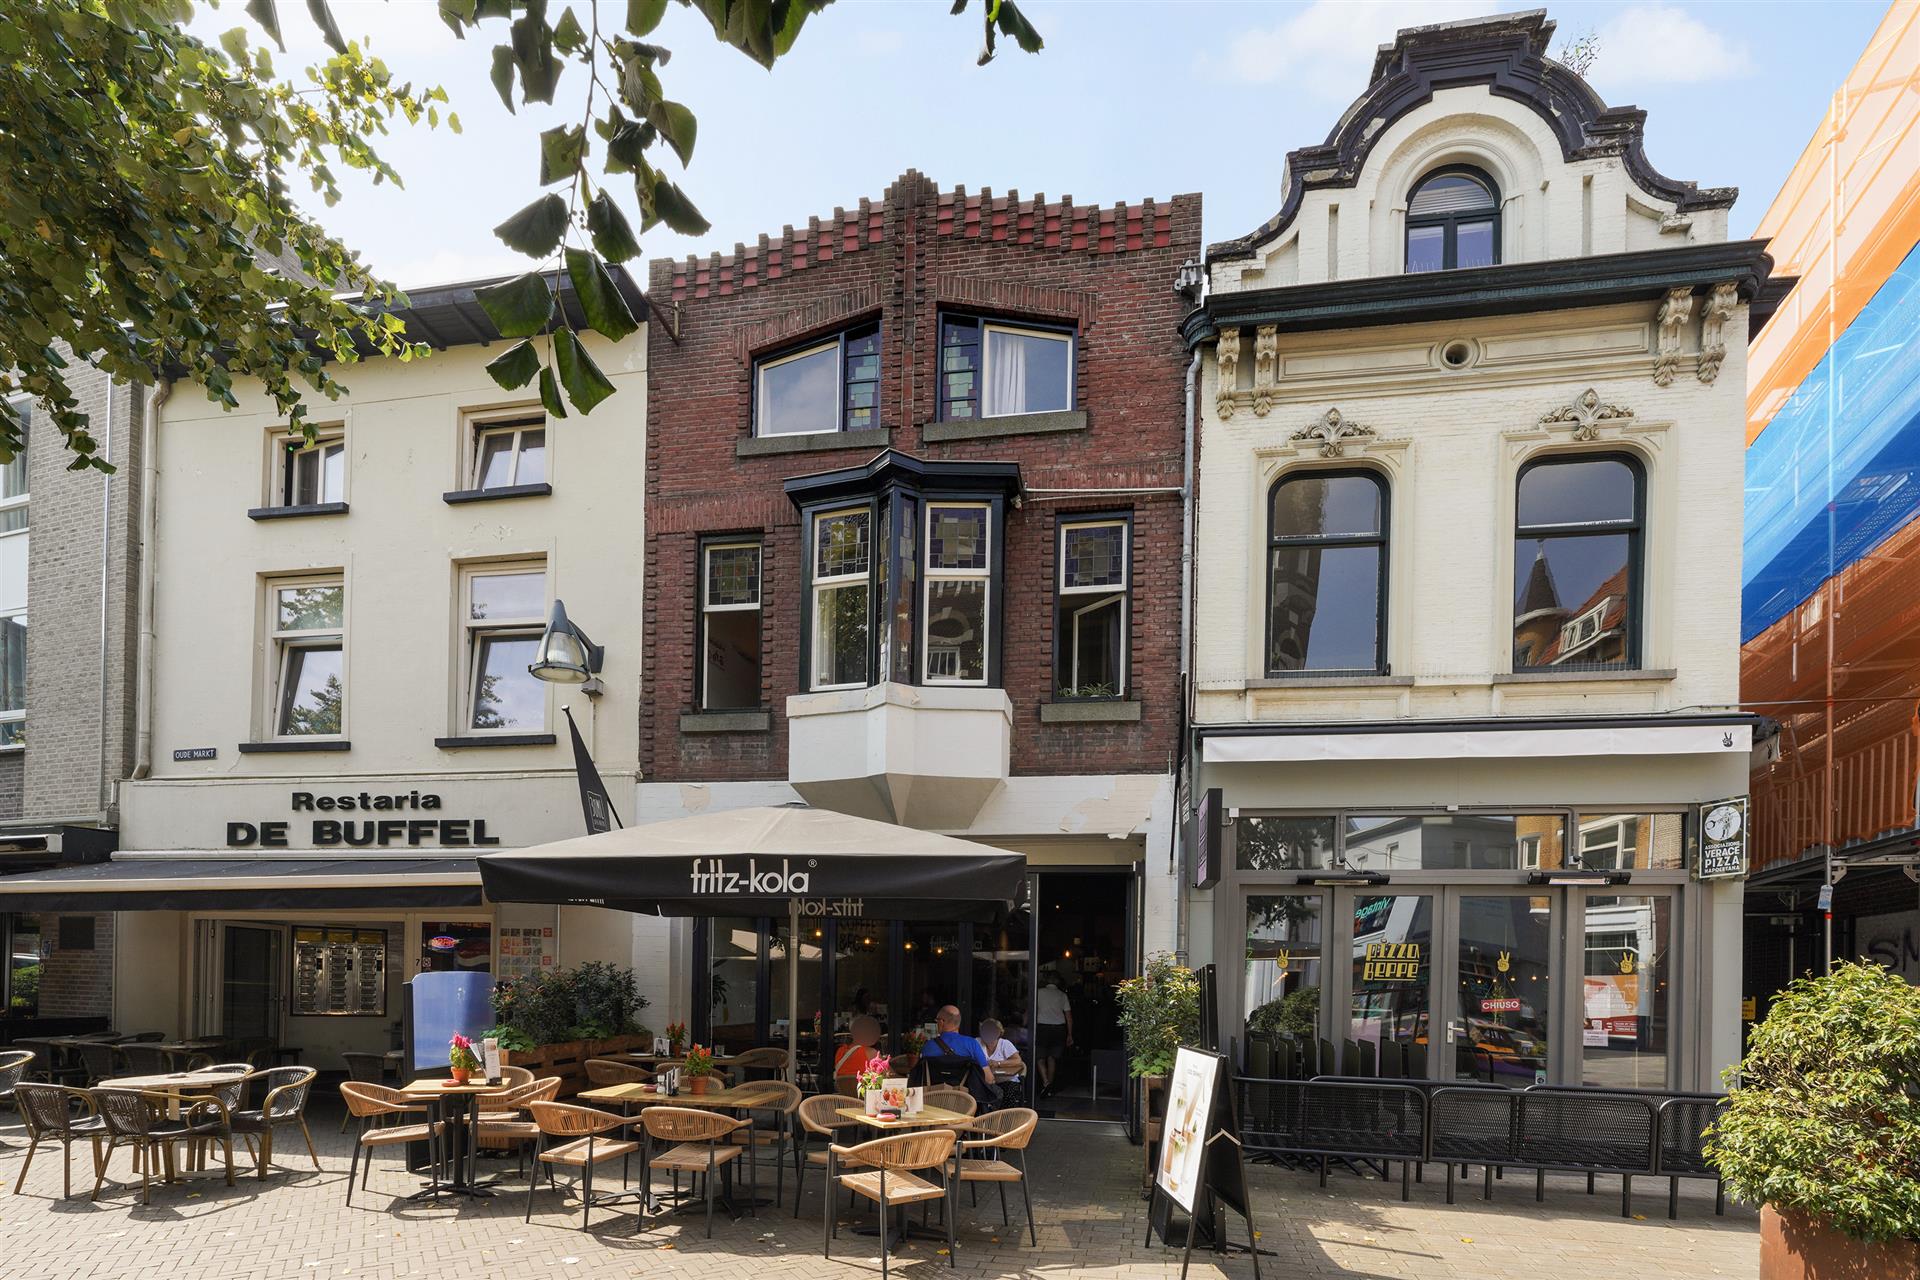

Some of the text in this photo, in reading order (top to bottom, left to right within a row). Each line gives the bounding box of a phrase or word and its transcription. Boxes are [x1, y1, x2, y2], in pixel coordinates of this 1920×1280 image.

[175, 750, 214, 759] OUDE MARKT
[291, 790, 442, 811] Restaria
[226, 819, 501, 847] DE BUFFEL
[1704, 847, 1740, 858] VERACE
[1704, 856, 1740, 868] PIZZA
[1482, 1000, 1519, 1010] CHIUSO
